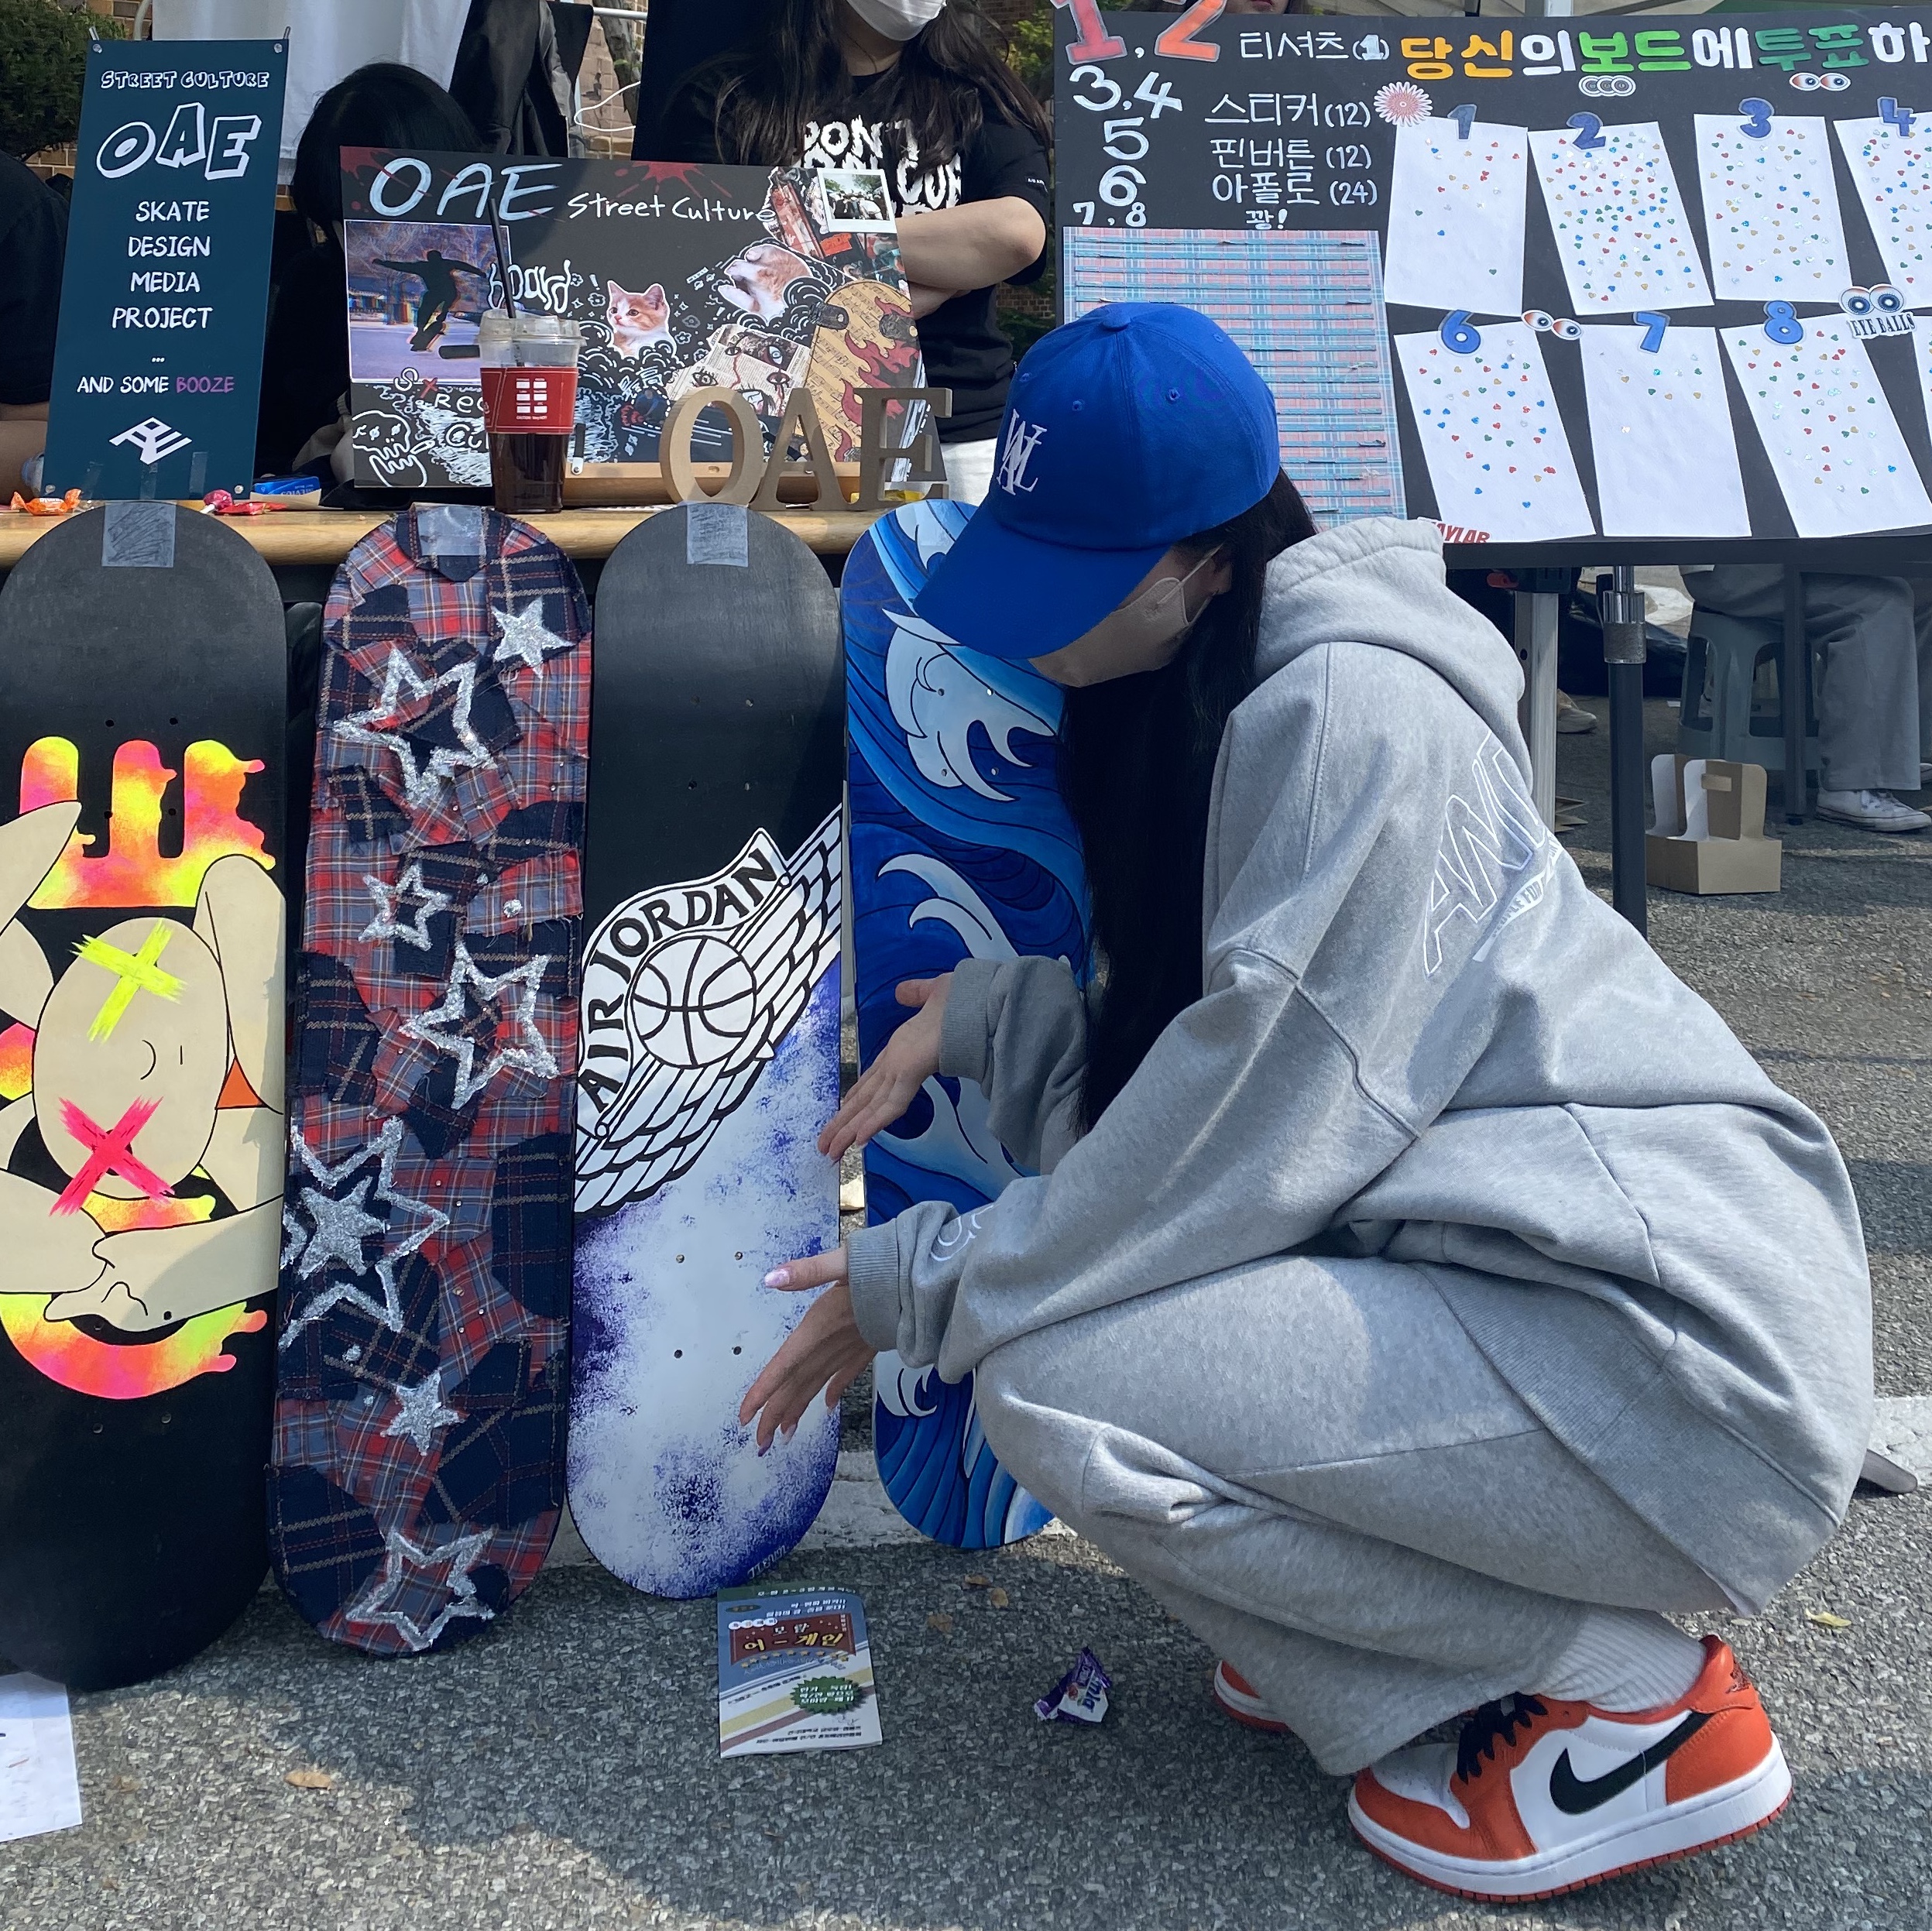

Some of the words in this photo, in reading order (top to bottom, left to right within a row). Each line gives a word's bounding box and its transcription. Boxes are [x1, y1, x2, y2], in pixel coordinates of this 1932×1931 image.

[101, 71, 177, 89] STREET
[180, 71, 269, 88] CULTURE
[1448, 105, 1477, 139] 1
[1568, 111, 1607, 150] 2
[1738, 98, 1774, 138] 3
[1878, 97, 1917, 137] 4
[96, 102, 261, 180] OAE
[1103, 117, 1149, 160] 5
[1210, 138, 1315, 170] 핀버튼
[369, 157, 562, 222] OAE
[568, 193, 666, 220] Street
[671, 198, 776, 222] Culture
[1099, 165, 1147, 207] 6
[1213, 172, 1319, 204] 아폴로
[136, 201, 210, 222] SKATE
[128, 235, 211, 257] DESIGN
[130, 271, 200, 293] MEDIA
[112, 307, 212, 329] PROJECT
[1441, 310, 1481, 354] 6
[1635, 311, 1669, 353] 7
[1765, 300, 1804, 344] 8
[1851, 318, 1879, 337] EYE
[1879, 313, 1916, 334] BALLS
[77, 376, 115, 393] AND
[120, 376, 169, 393] SOME
[176, 376, 235, 393] BOOZE
[659, 386, 952, 507] OAE
[591, 849, 777, 984] JORDAN
[578, 993, 629, 1113] AIR
